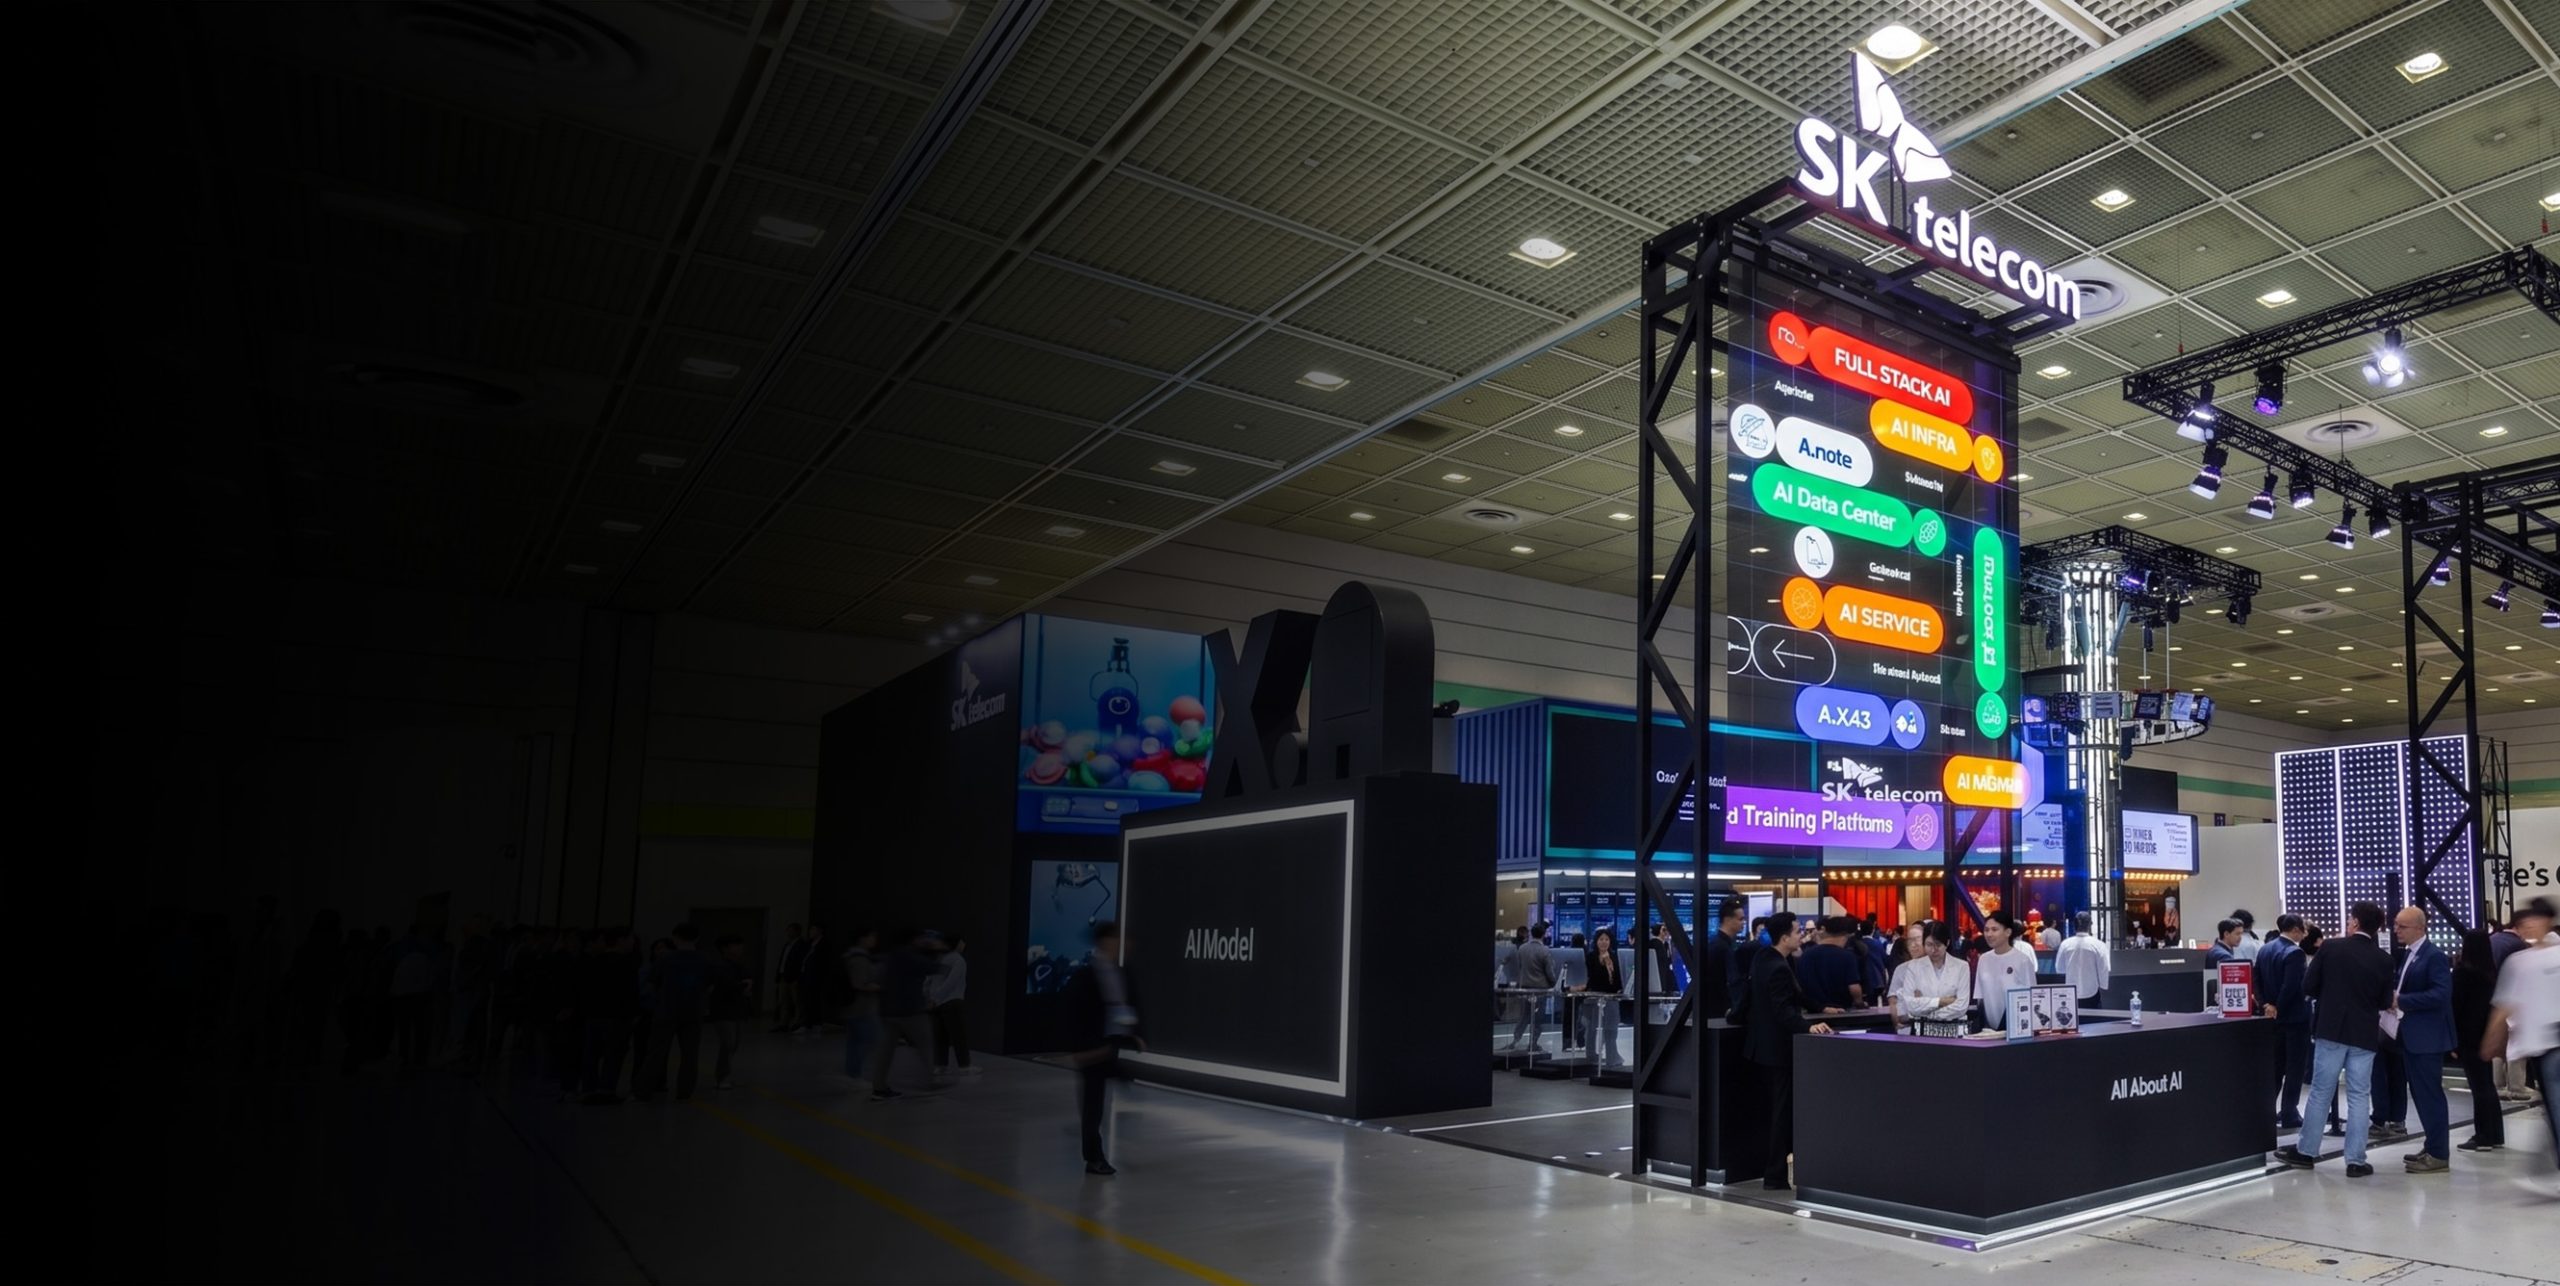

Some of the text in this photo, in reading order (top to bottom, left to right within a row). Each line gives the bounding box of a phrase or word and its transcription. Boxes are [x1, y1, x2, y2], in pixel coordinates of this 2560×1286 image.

[1797, 116, 2082, 321] SK telecom
[1835, 347, 1951, 407] FULL STACK AI
[1799, 437, 1853, 470] A.note
[1890, 416, 1957, 456] AI INFRA
[1773, 480, 1896, 532] AI Data Center
[1840, 602, 1930, 639] AI SERVICE
[951, 692, 1006, 731] SK telecom
[1821, 781, 1943, 803] SK telecom
[1957, 772, 1971, 790] AI
[1742, 804, 1817, 835] Training
[1184, 927, 1254, 962] AI Model
[2110, 1069, 2183, 1101] All About AI
